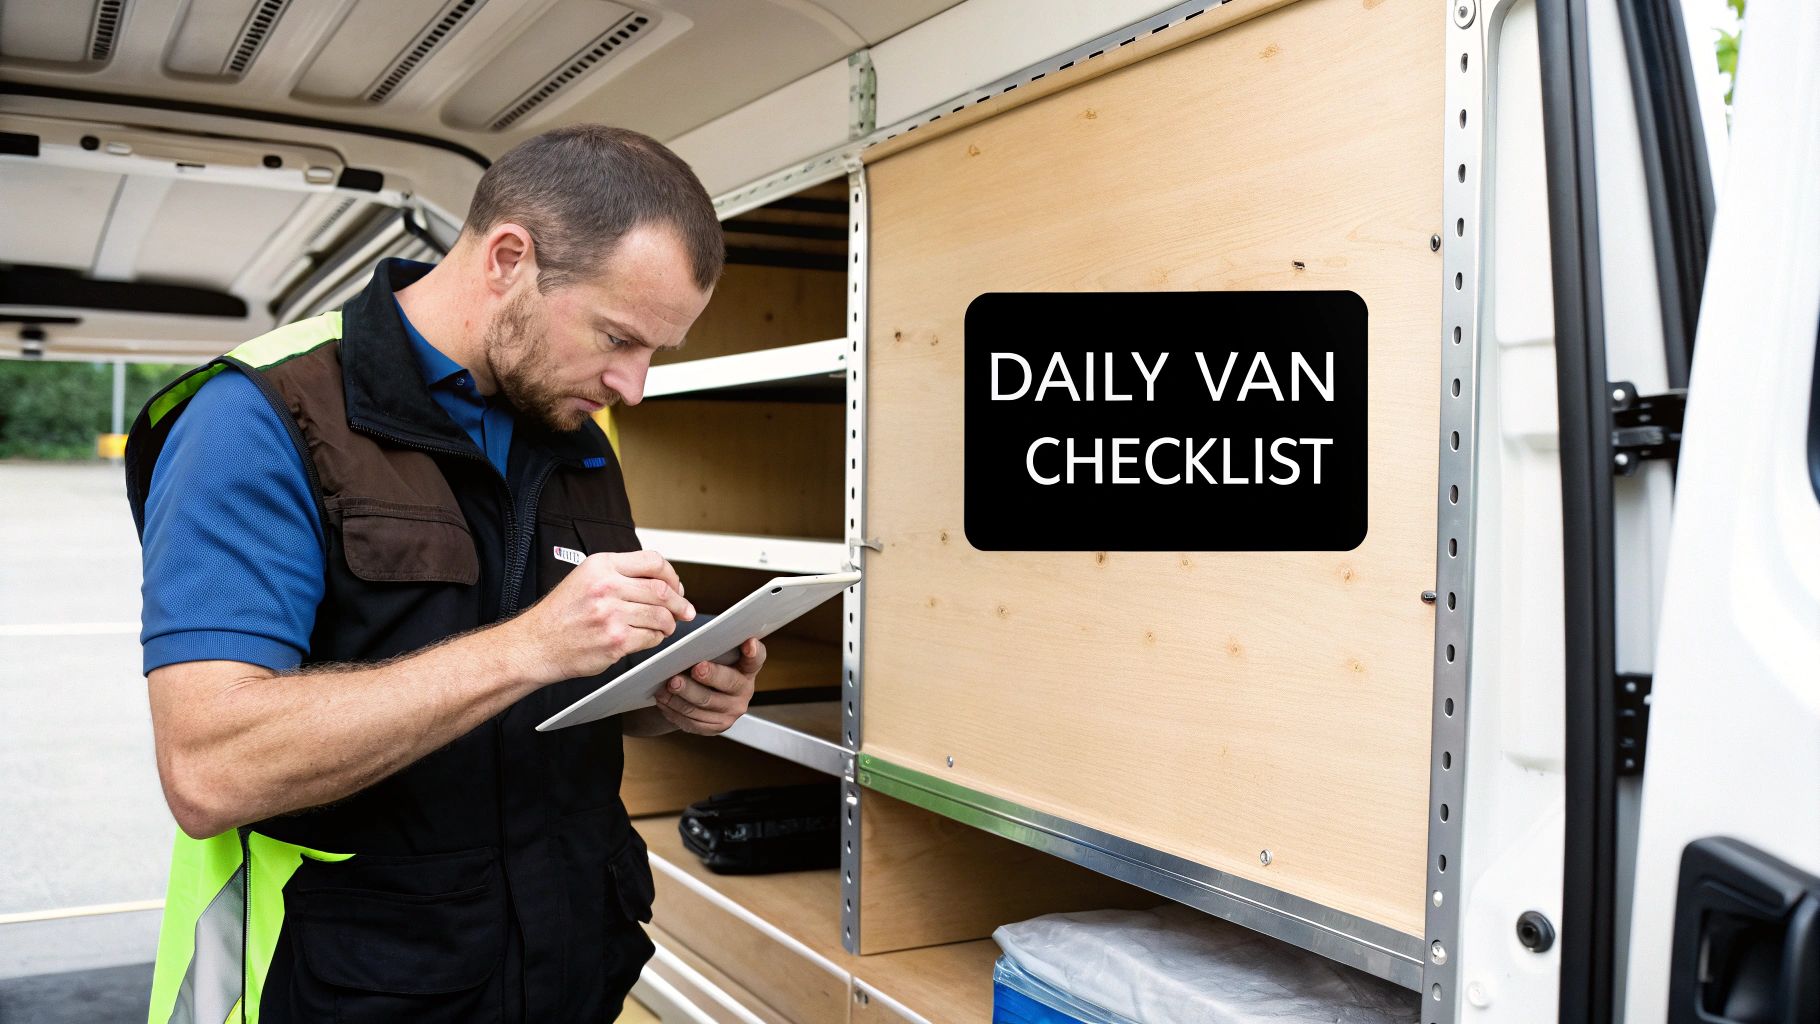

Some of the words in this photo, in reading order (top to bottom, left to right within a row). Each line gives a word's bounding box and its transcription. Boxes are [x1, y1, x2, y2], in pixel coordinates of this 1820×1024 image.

[990, 352, 1169, 402] DAILY
[1195, 352, 1335, 402] VAN
[1026, 436, 1334, 486] CHECKLIST
